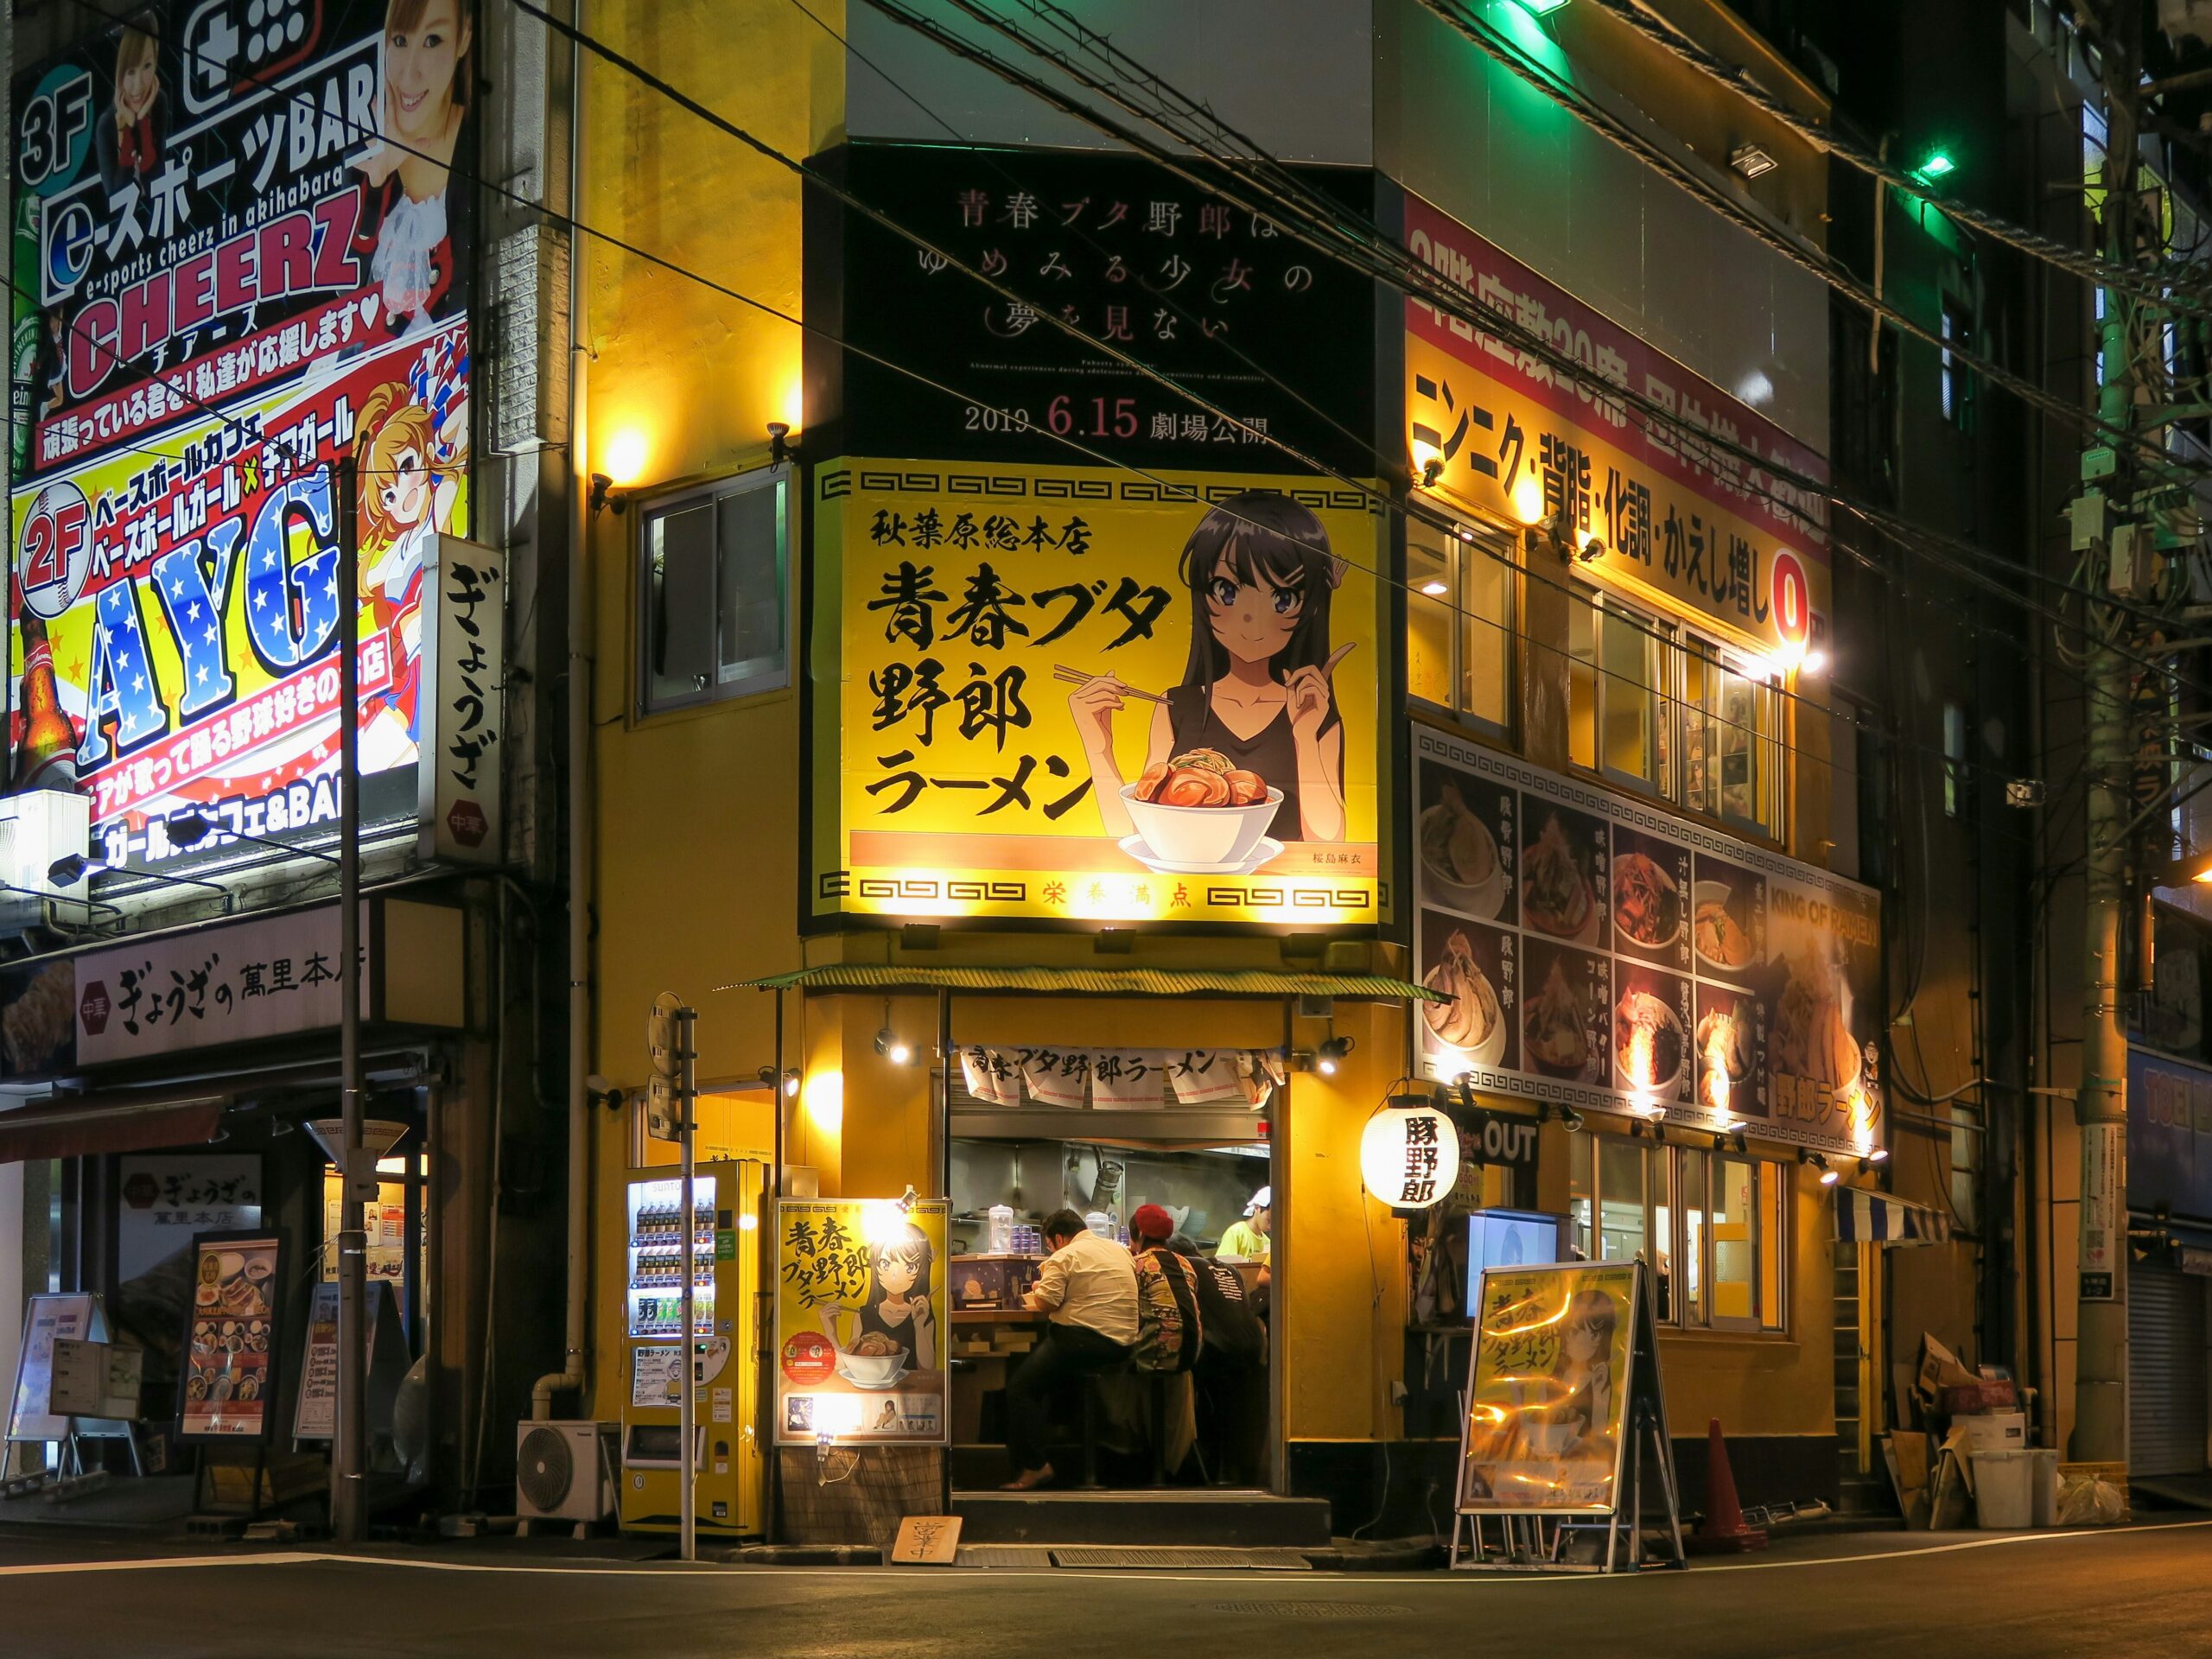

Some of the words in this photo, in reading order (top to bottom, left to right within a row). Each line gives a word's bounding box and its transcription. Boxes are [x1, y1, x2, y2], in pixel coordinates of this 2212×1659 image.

[20, 73, 92, 186] 3F
[86, 250, 153, 299] e-sports
[159, 225, 215, 267] cheerz
[221, 212, 239, 240] in
[245, 166, 344, 230] akihabara
[957, 187, 1280, 241] 青春ブタ野郎は
[69, 185, 360, 399] CHEERZ
[918, 248, 1313, 294] ゆめみる少女の
[1048, 394, 1139, 437] 6.15
[1150, 411, 1270, 445] 劇場公開
[24, 504, 86, 589] 2F
[869, 508, 1092, 556] 秋葉原総本店
[78, 465, 340, 766] AYG
[867, 561, 1173, 652] 青春ブタ
[446, 560, 500, 789] ぎょうざ
[870, 658, 1033, 753] 野郎
[864, 749, 1092, 820] ラーメン
[451, 813, 484, 836] 中華
[1312, 852, 1363, 865] 桜島麻衣
[1042, 881, 1192, 907] 栄養満点
[1770, 887, 1806, 924] KING
[1808, 899, 1827, 928] OF
[1830, 906, 1877, 947] RAMEN
[82, 996, 107, 1020] 中華
[1777, 1071, 1881, 1131] 野郎ラーメン
[1400, 1116, 1438, 1203] 豚野郎
[1484, 1120, 1536, 1162] OUT
[164, 1173, 256, 1207] ぎょうざの
[785, 1216, 852, 1258] 青春
[781, 1245, 871, 1290] ブタ野郎
[798, 1281, 866, 1309] ラーメン
[910, 1522, 946, 1558] 営業中
